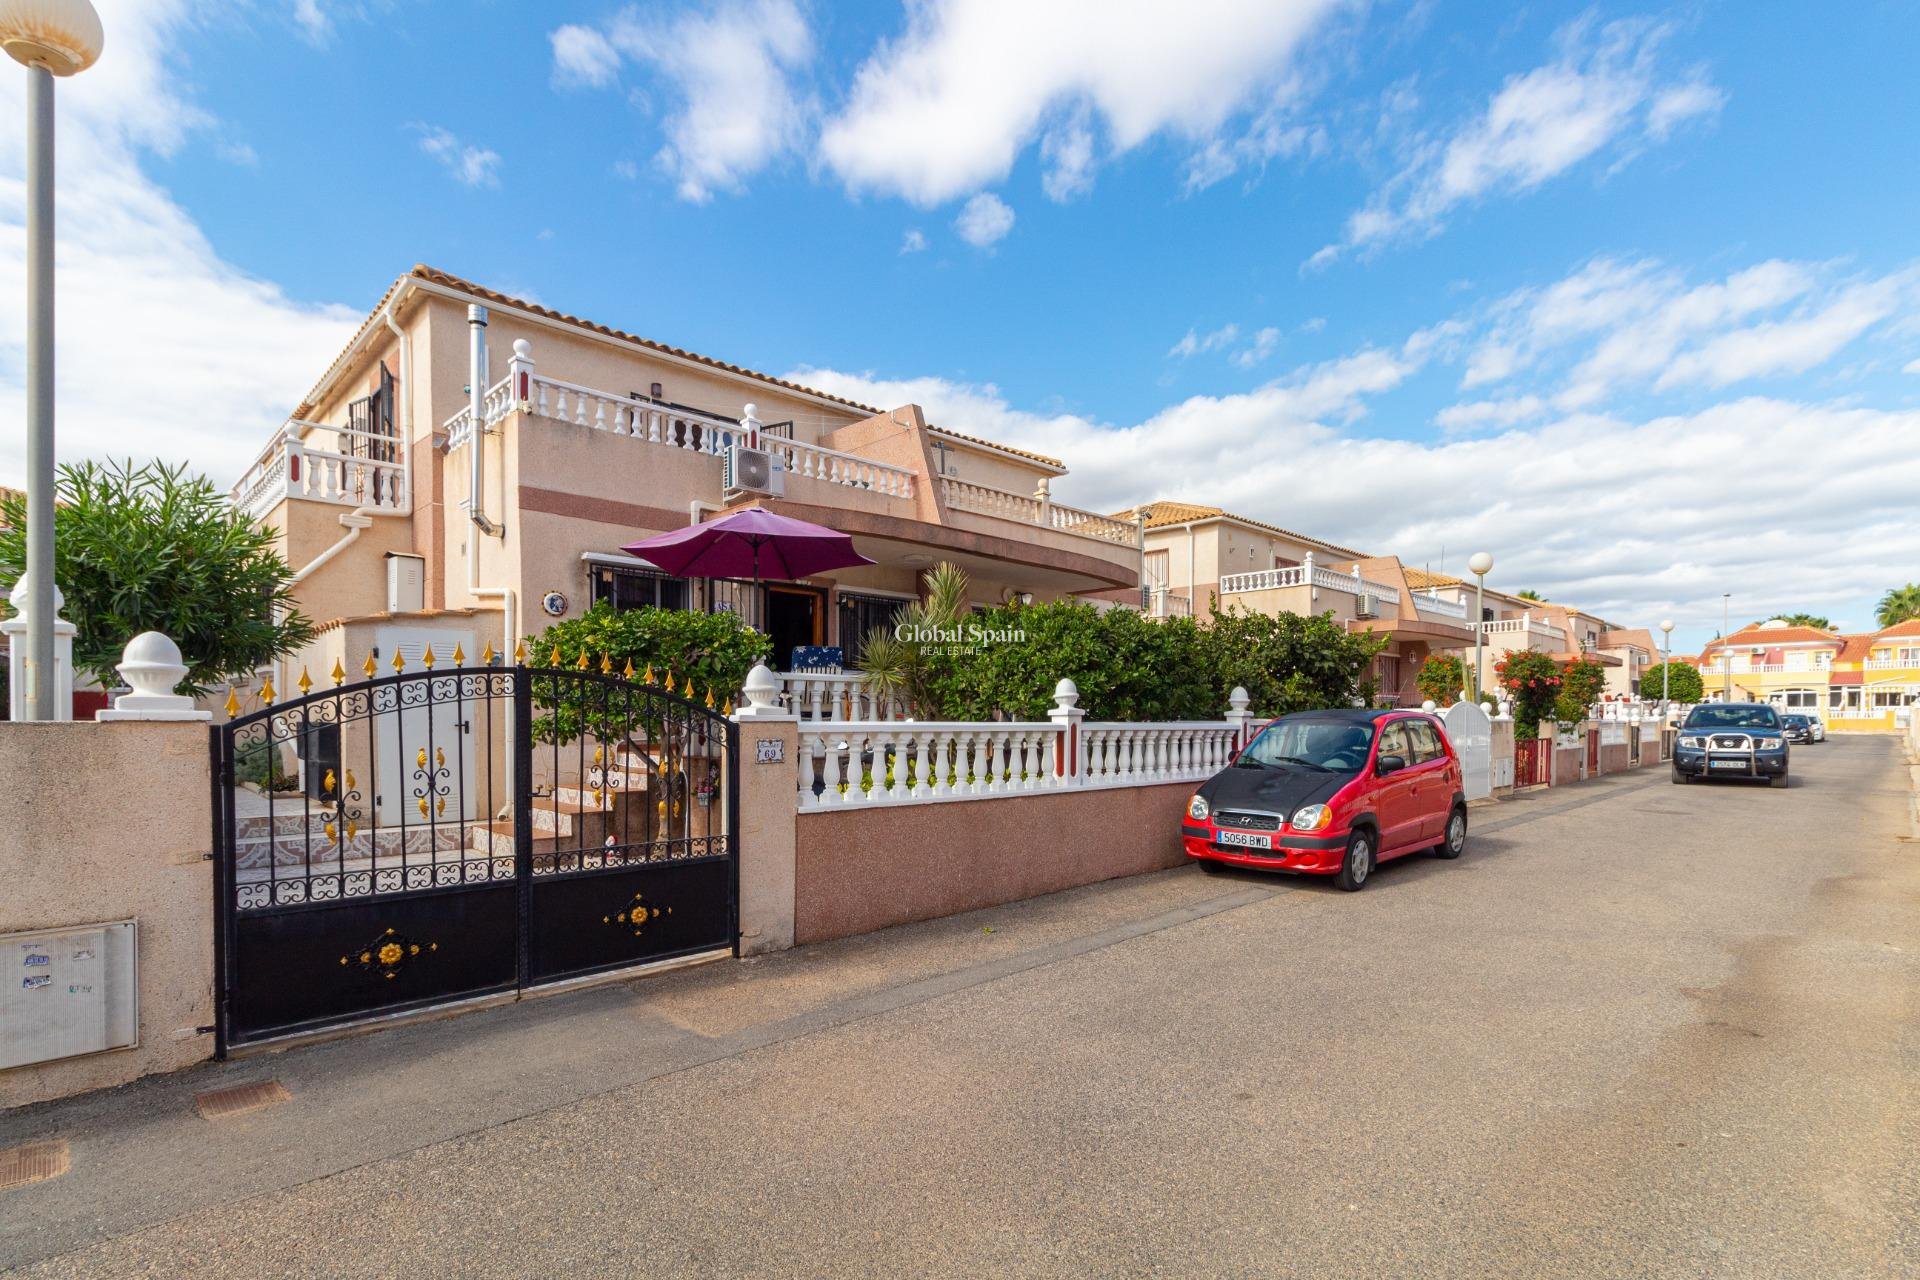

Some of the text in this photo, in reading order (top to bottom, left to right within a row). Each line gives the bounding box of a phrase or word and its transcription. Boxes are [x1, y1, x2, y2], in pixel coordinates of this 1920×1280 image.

[764, 749, 776, 759] 69
[1224, 832, 1268, 847] 5056 BWD
